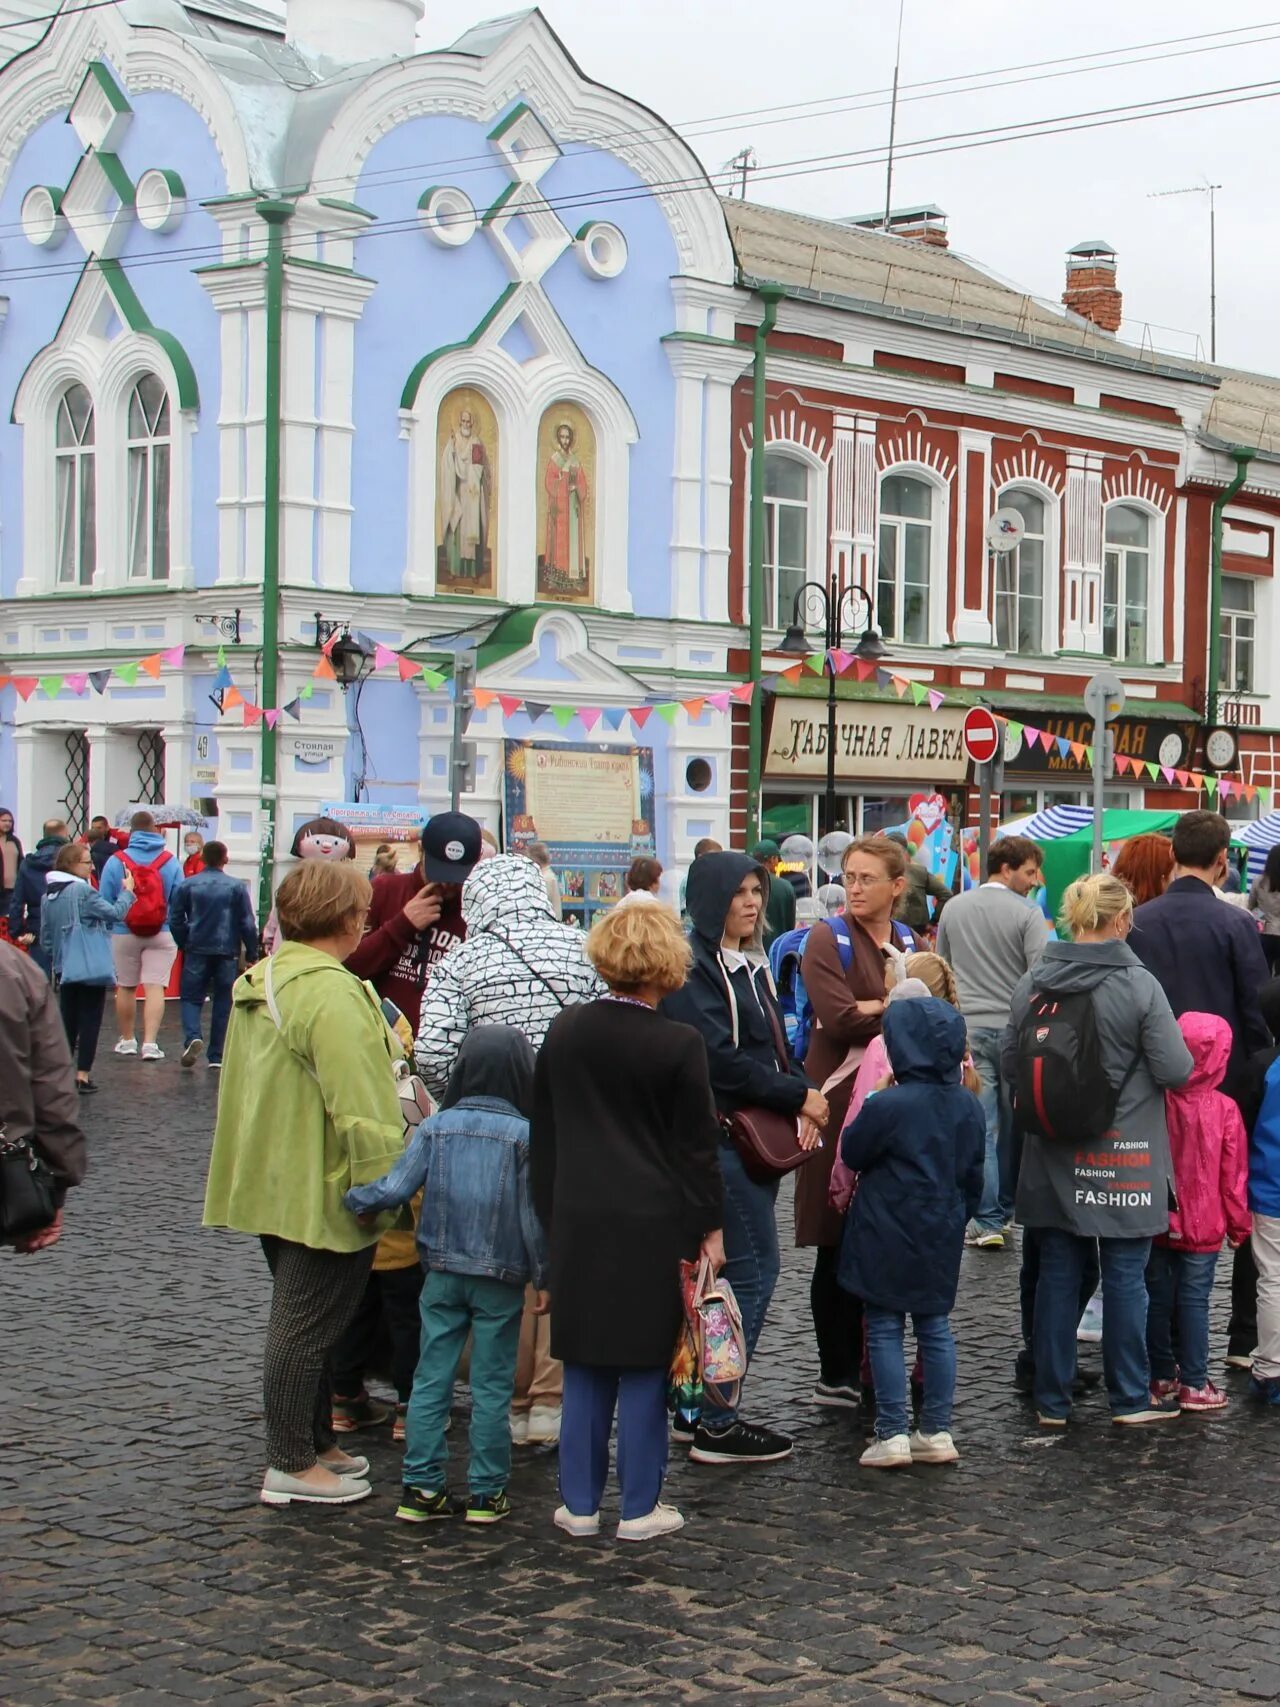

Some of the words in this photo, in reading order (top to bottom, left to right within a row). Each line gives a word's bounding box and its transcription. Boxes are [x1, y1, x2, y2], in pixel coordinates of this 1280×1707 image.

[771, 718, 893, 764] ТАБЧНАЯ
[1113, 1141, 1149, 1150] FASHION
[1074, 1151, 1151, 1167] FASHION
[1075, 1168, 1116, 1178] FASHION
[1075, 1190, 1152, 1206] FASHION
